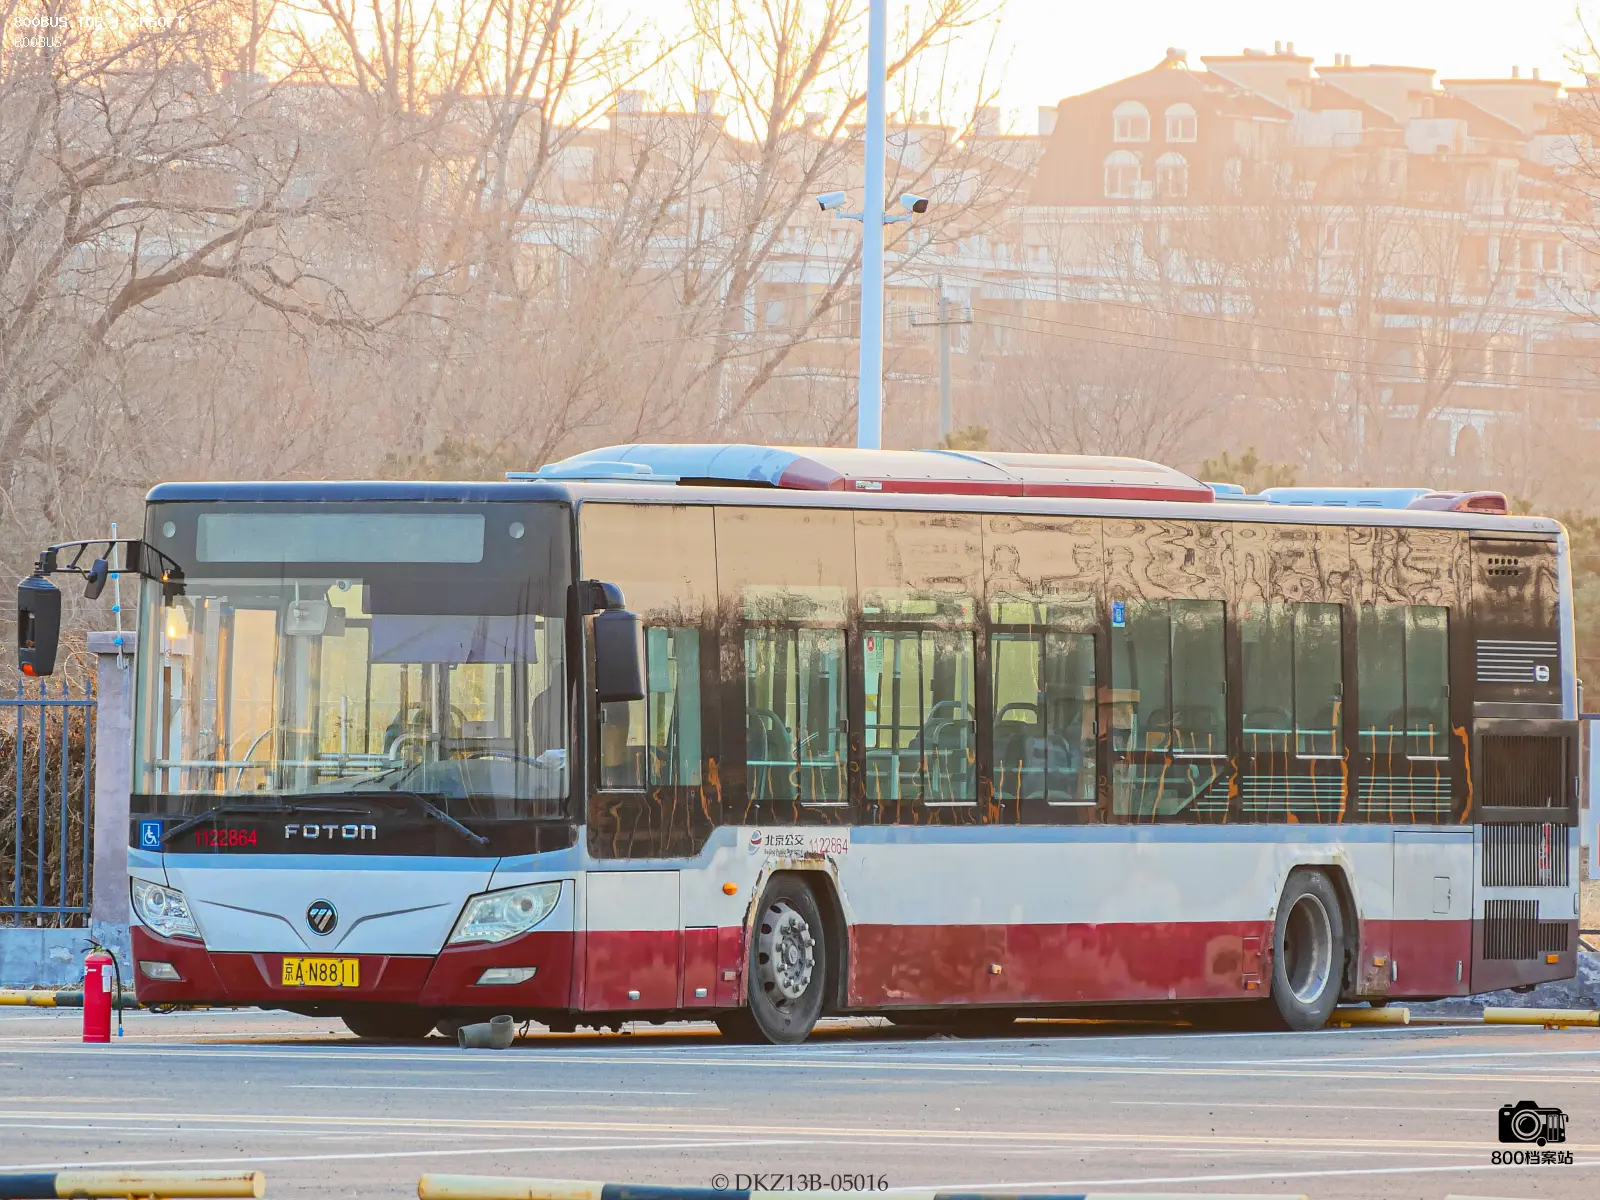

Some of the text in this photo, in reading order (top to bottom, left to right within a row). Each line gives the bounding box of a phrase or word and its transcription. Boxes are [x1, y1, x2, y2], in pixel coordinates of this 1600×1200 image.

[195, 829, 257, 847] 1122864
[284, 823, 378, 840] FOTON
[764, 834, 804, 846] 北京公交
[808, 837, 849, 855] 1122864
